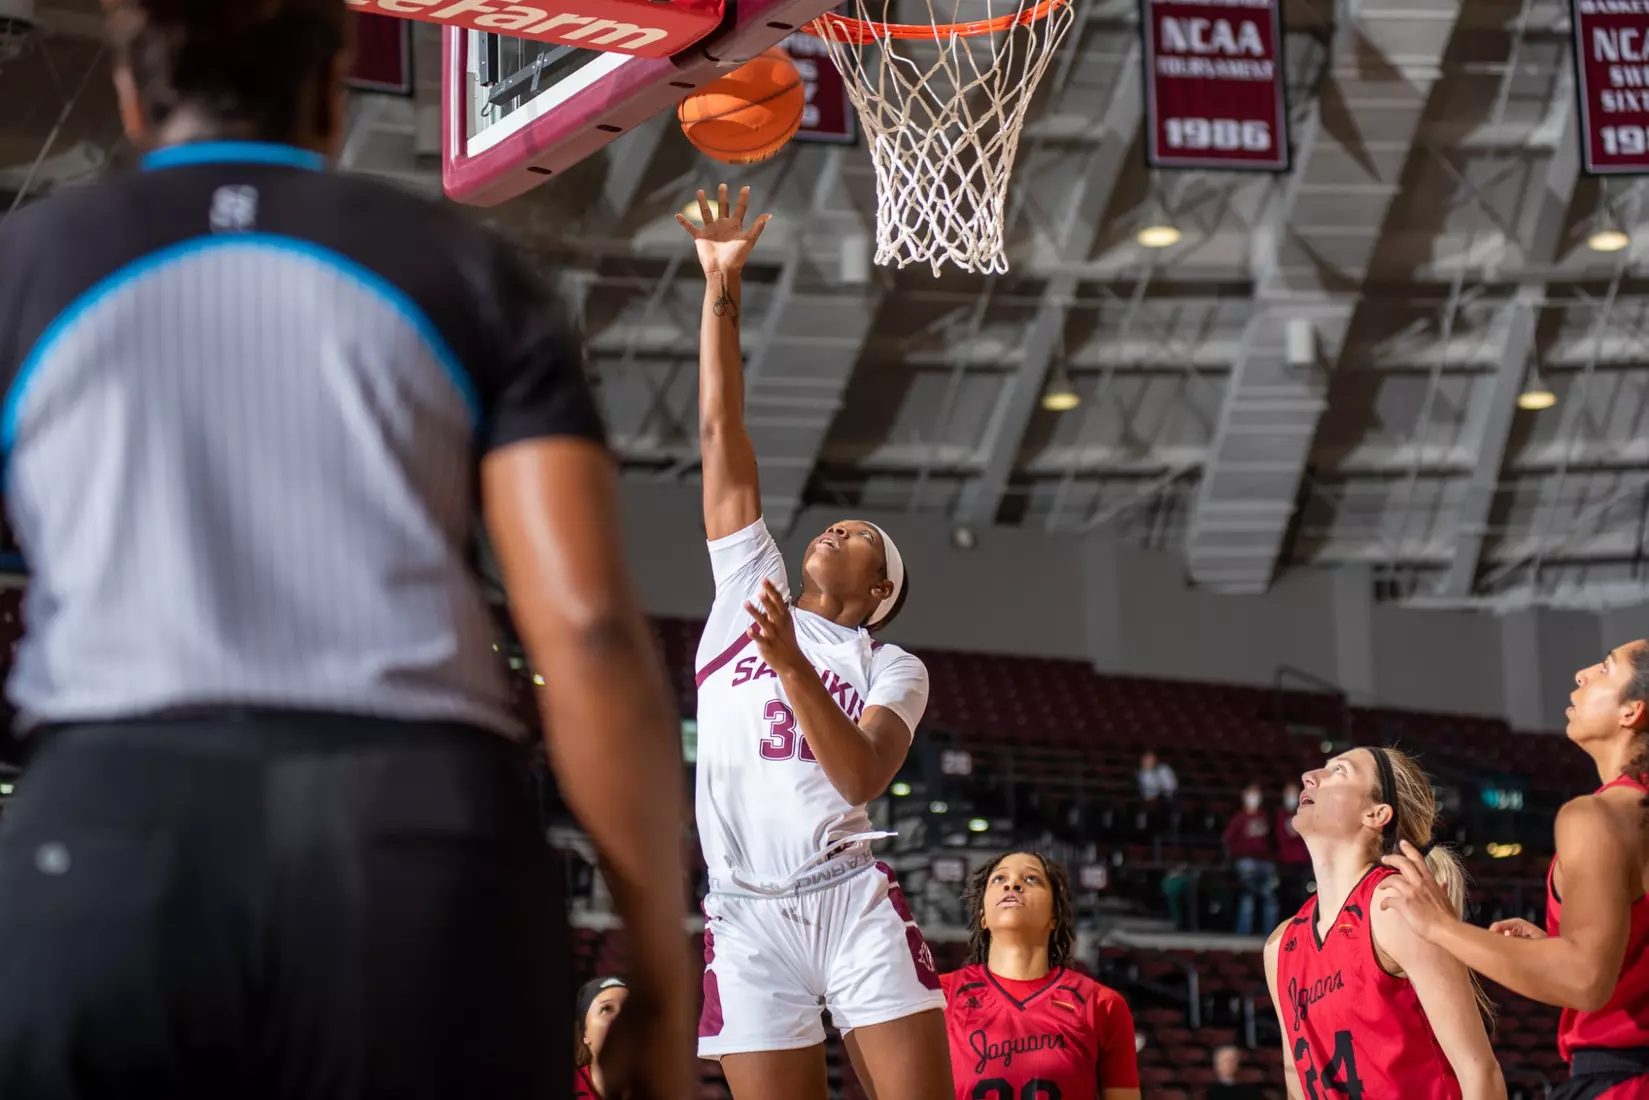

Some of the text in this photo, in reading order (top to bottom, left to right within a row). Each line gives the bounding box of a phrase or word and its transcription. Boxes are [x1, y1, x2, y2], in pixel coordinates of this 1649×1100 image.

[1161, 15, 1265, 57] NCAA
[1165, 117, 1271, 151] 1986
[1601, 126, 1649, 155] 19
[1288, 970, 1344, 1031] Jguars
[970, 1029, 1067, 1074] Jaguars
